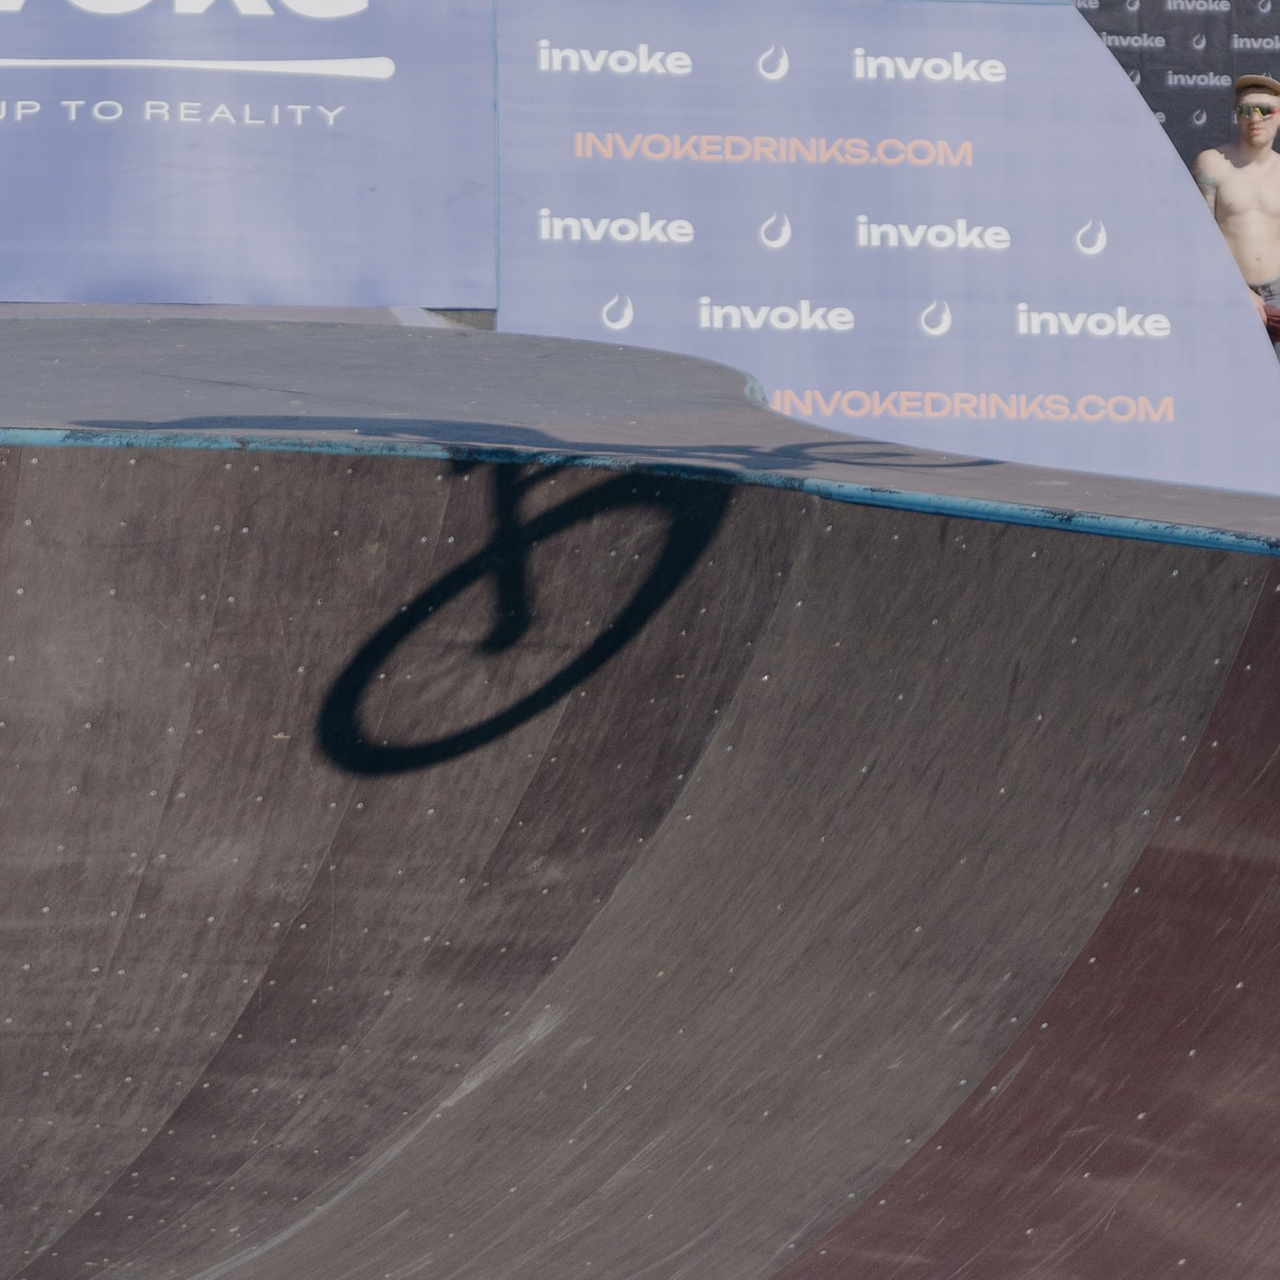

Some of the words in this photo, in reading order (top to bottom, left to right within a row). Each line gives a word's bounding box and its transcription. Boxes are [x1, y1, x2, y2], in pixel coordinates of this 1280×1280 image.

[1102, 32, 1165, 47] invoke
[540, 40, 692, 74] invoke
[855, 48, 1006, 82] invoke
[1168, 71, 1231, 86] invoke
[0, 101, 41, 121] P
[61, 100, 124, 121] TO
[145, 101, 345, 125] REALITY
[575, 132, 972, 167] INVOKEDRINKS.COM
[540, 208, 694, 242] invoke
[858, 215, 1010, 249] invoke
[700, 297, 854, 330] invoke
[1018, 303, 1170, 337] invoke
